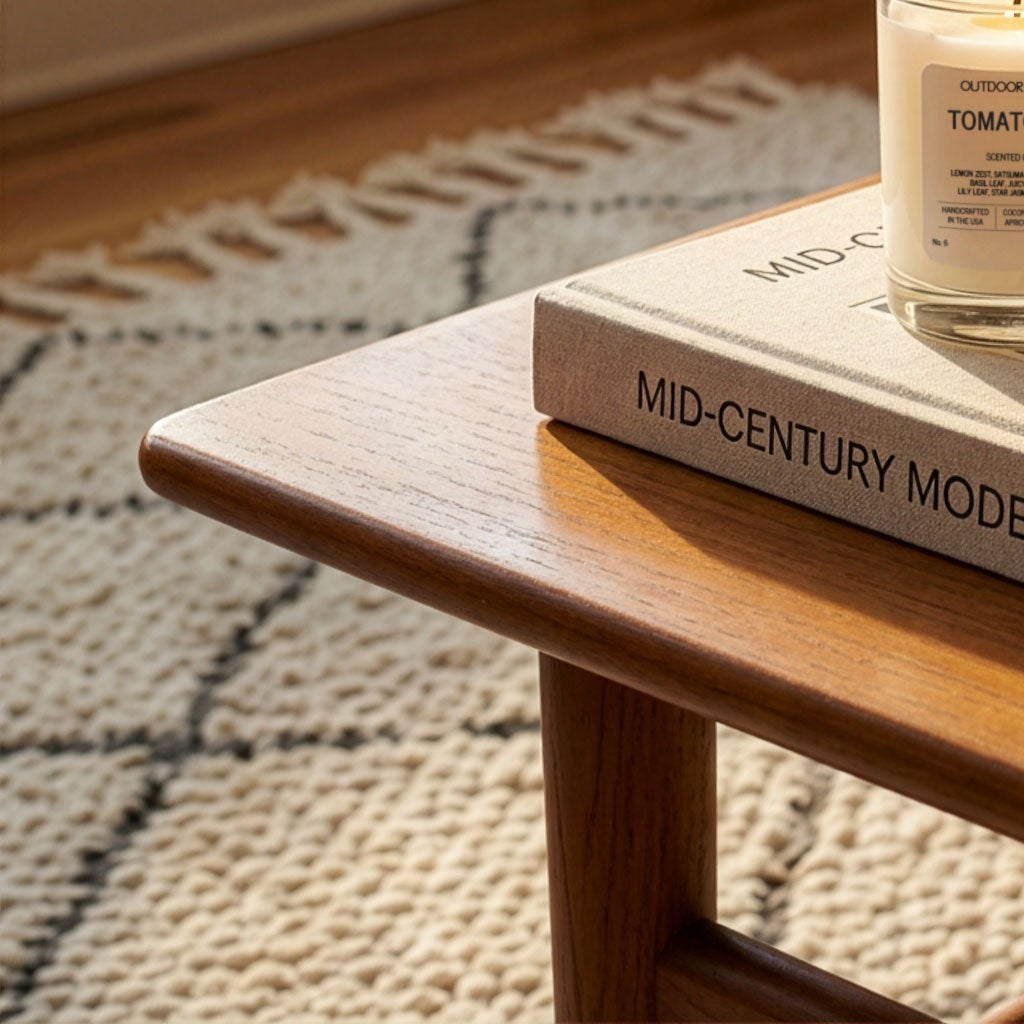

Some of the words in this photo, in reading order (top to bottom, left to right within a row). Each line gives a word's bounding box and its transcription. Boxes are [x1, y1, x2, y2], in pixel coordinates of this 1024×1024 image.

[960, 80, 1023, 92] OUTDOOR
[986, 152, 1020, 161] SCENTED
[950, 169, 973, 177] LEMON
[957, 187, 971, 195] LILY
[941, 206, 989, 215] HANDCRAFTED
[956, 216, 969, 224] THE
[970, 217, 984, 225] USA
[743, 225, 884, 282] MID-C
[636, 369, 896, 493] MID-CENTURY
